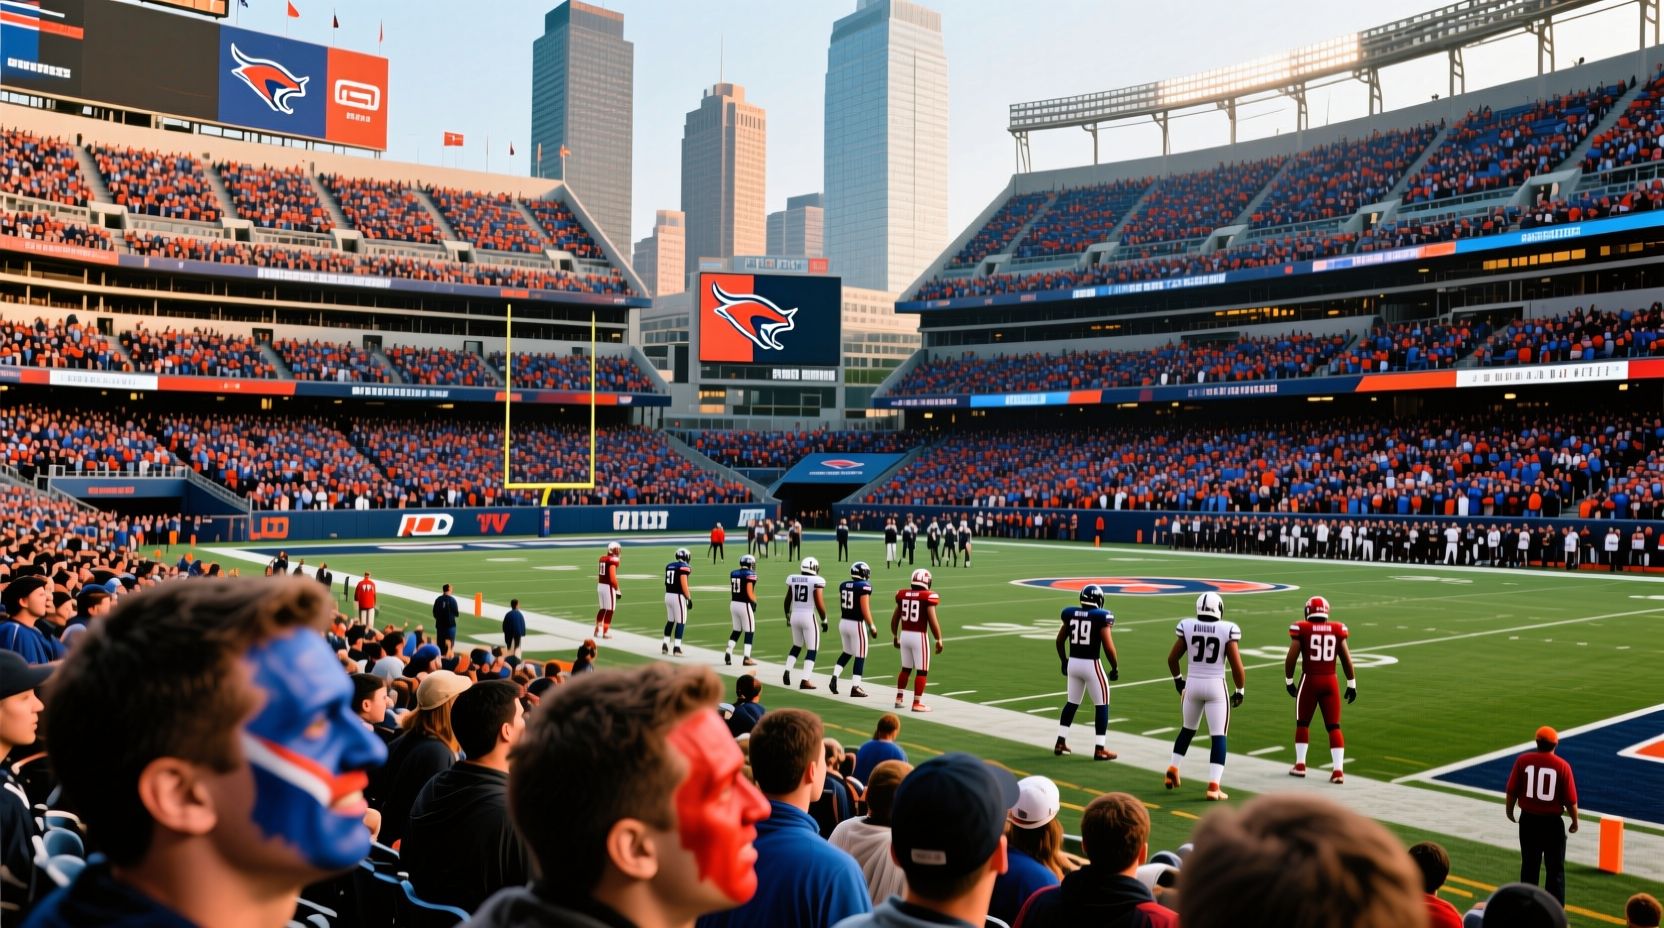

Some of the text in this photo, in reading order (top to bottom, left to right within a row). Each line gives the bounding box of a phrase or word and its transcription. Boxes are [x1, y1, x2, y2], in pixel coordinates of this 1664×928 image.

[1069, 619, 1092, 645] 39
[1310, 634, 1337, 662] 58
[1524, 765, 1557, 802] 10
